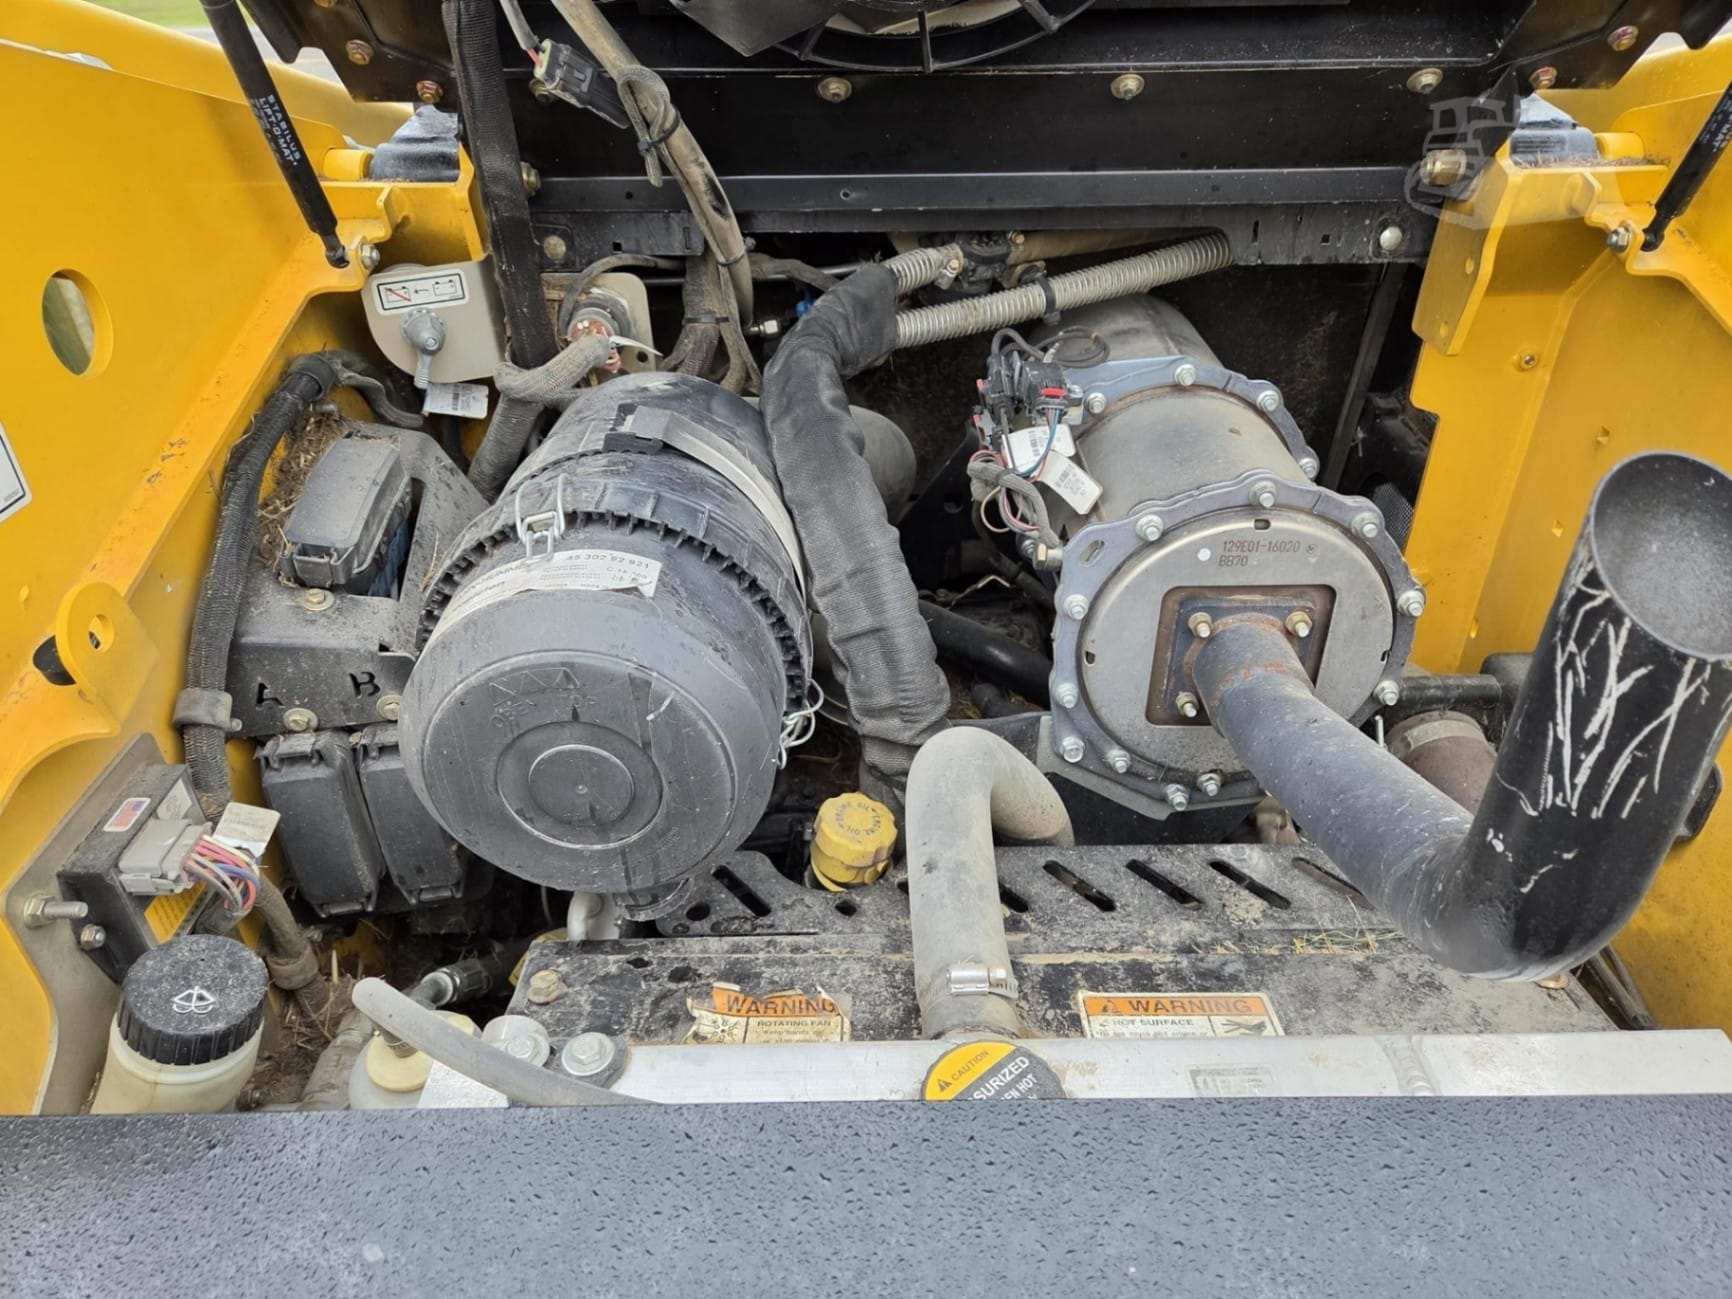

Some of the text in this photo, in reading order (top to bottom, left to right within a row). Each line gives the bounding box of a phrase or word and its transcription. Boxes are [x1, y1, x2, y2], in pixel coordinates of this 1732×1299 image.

[267, 94, 301, 160] STABILUS
[726, 993, 836, 1015] WARNING
[1128, 999, 1252, 1014] WARNING
[757, 1020, 832, 1028] ROTATING FAN
[1140, 1018, 1195, 1027] SURFACE
[951, 1050, 990, 1081] CAUTION
[968, 1055, 1029, 1100] SURIZED
[1016, 1073, 1038, 1094] HOT
